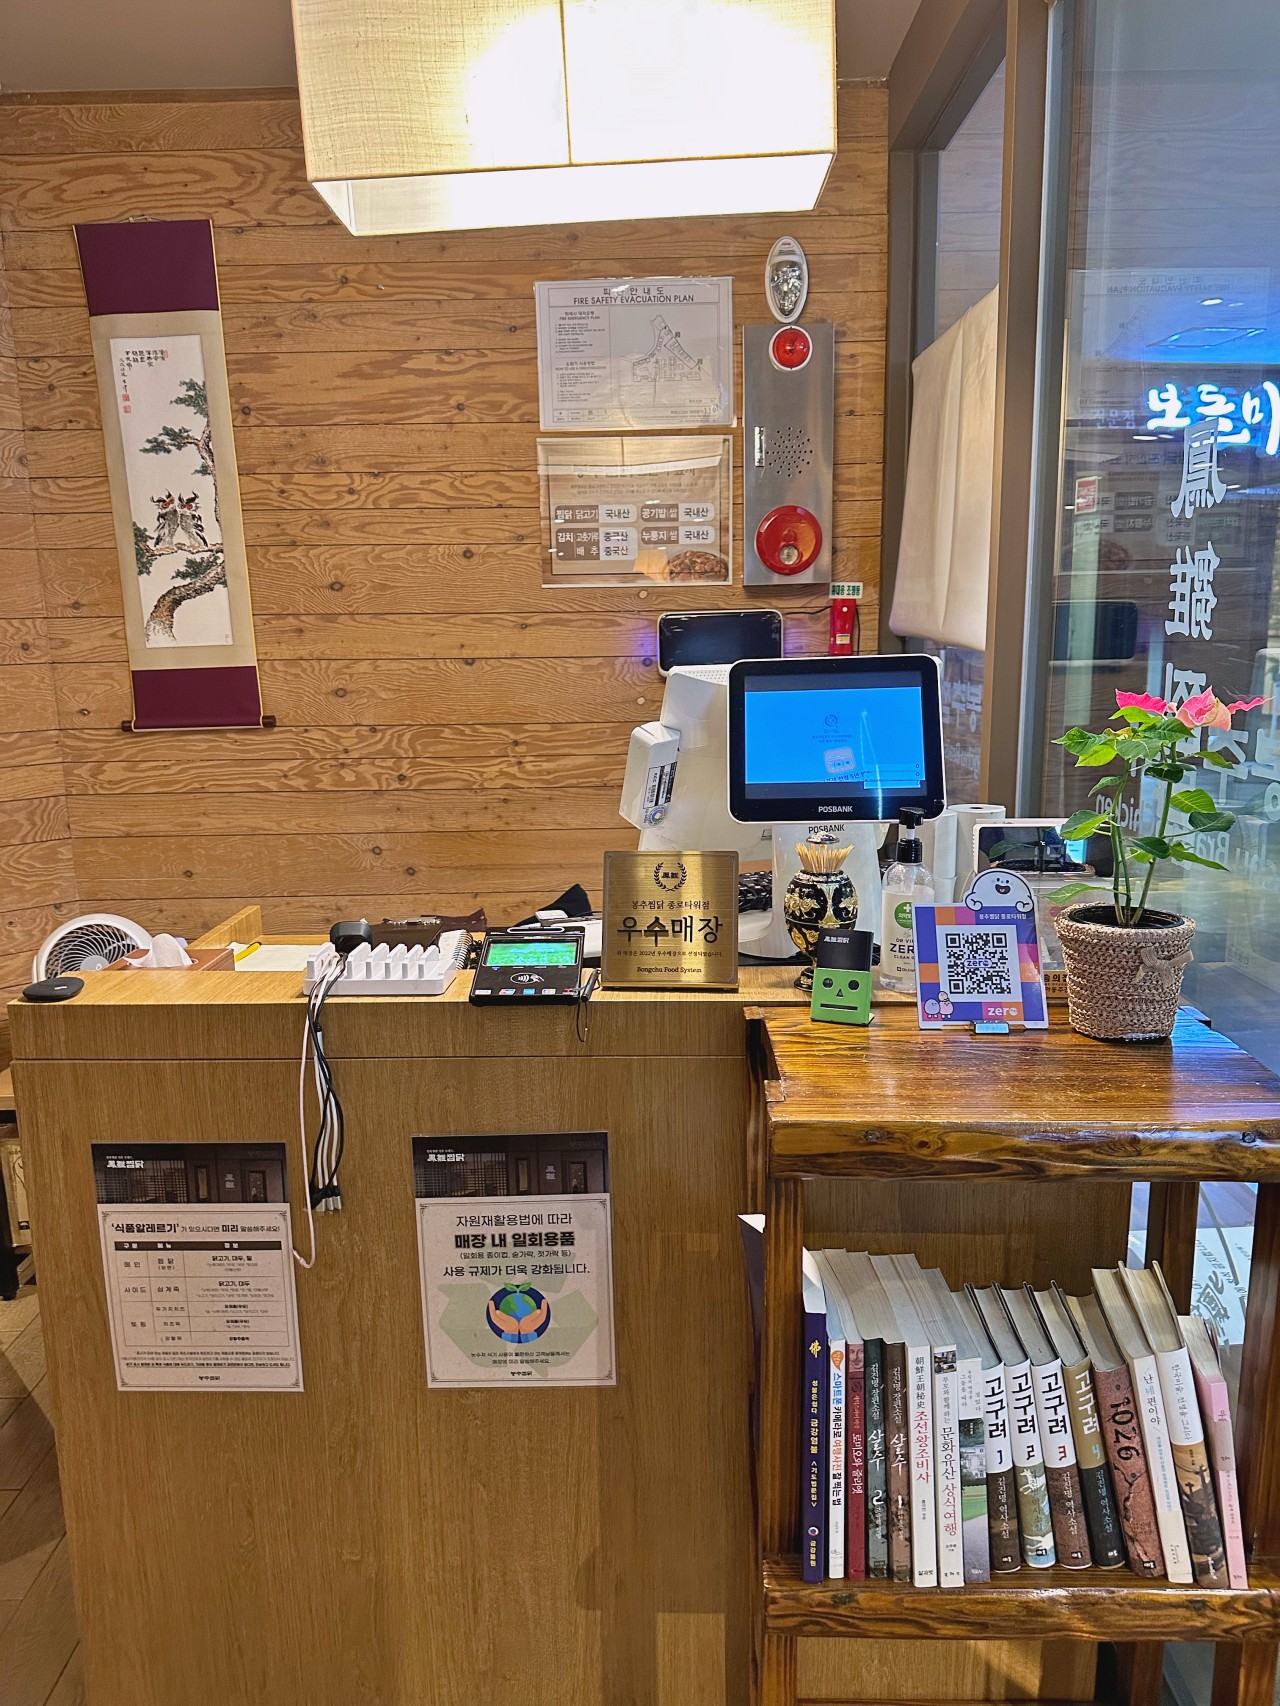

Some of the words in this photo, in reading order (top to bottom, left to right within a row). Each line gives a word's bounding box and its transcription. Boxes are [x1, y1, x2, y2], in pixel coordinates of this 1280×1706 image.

[573, 297, 589, 305] FIRE
[591, 296, 618, 304] SAFETY
[620, 295, 672, 304] EVACUATION
[674, 294, 694, 303] PLAN
[556, 509, 573, 520] 찜닭
[576, 509, 599, 520] 닭고기
[605, 509, 630, 519] 국내산
[641, 508, 667, 519] 공기밥
[669, 508, 678, 518] 쌀
[684, 507, 709, 518] 국내산
[557, 532, 574, 543] 김치
[604, 532, 628, 542] 중국산
[642, 531, 667, 541] 누룽지
[669, 531, 678, 541] 쌀
[684, 530, 709, 541] 국내산
[604, 546, 628, 556] 중국산
[818, 805, 853, 813] POSBANK
[808, 823, 845, 834] POSBANK
[632, 900, 664, 910] 봉추찜닭
[667, 900, 710, 910] 종로타워점
[617, 915, 724, 947] 우수매장
[890, 942, 915, 954] ZER
[988, 1006, 1018, 1016] zero
[222, 1224, 238, 1232] 미리
[456, 1214, 544, 1227] 자원재활용법에
[547, 1213, 572, 1225] 따라
[454, 1233, 487, 1249] 매장
[491, 1232, 507, 1248] 내
[511, 1231, 575, 1248] 일회용품
[443, 1266, 465, 1277] 사용
[468, 1265, 502, 1277] 규제가
[505, 1264, 527, 1276] 더욱
[531, 1263, 590, 1275] 강화됩니다.
[833, 1373, 842, 1405] 스마트폰
[915, 1356, 926, 1409] 朝鮮王朝秘史
[1143, 1374, 1154, 1385] 난
[1075, 1369, 1100, 1435] 고구려
[1145, 1386, 1156, 1396] 네
[984, 1375, 1008, 1439] 고구려
[996, 1450, 1004, 1465] 1
[1012, 1372, 1036, 1434] 고구려
[1026, 1444, 1036, 1461] 2
[1042, 1372, 1067, 1434] 고구려
[1058, 1445, 1068, 1461] 3
[1147, 1396, 1162, 1426] 편이야
[832, 1406, 842, 1439] 카메라로
[1109, 1396, 1140, 1461] 1026
[1181, 1419, 1193, 1441] 그리다
[832, 1440, 842, 1471] 여행사진
[852, 1434, 863, 1467] 로미오와
[868, 1429, 885, 1472] 살수
[890, 1433, 907, 1476] 살수
[914, 1411, 931, 1484] 조선왕조비사
[941, 1427, 956, 1480] 문화유산
[832, 1472, 842, 1480] 잘
[852, 1469, 863, 1494] 줄리엣
[1062, 1471, 1073, 1498] 김진명
[832, 1481, 842, 1497] 찍는
[873, 1490, 884, 1505] 2
[997, 1476, 1007, 1503] 김진명
[832, 1498, 842, 1506] 법
[897, 1495, 903, 1508] 1
[942, 1483, 957, 1536] 상식여행
[999, 1504, 1010, 1539] 역사소설
[1065, 1500, 1078, 1535] 역사소설
